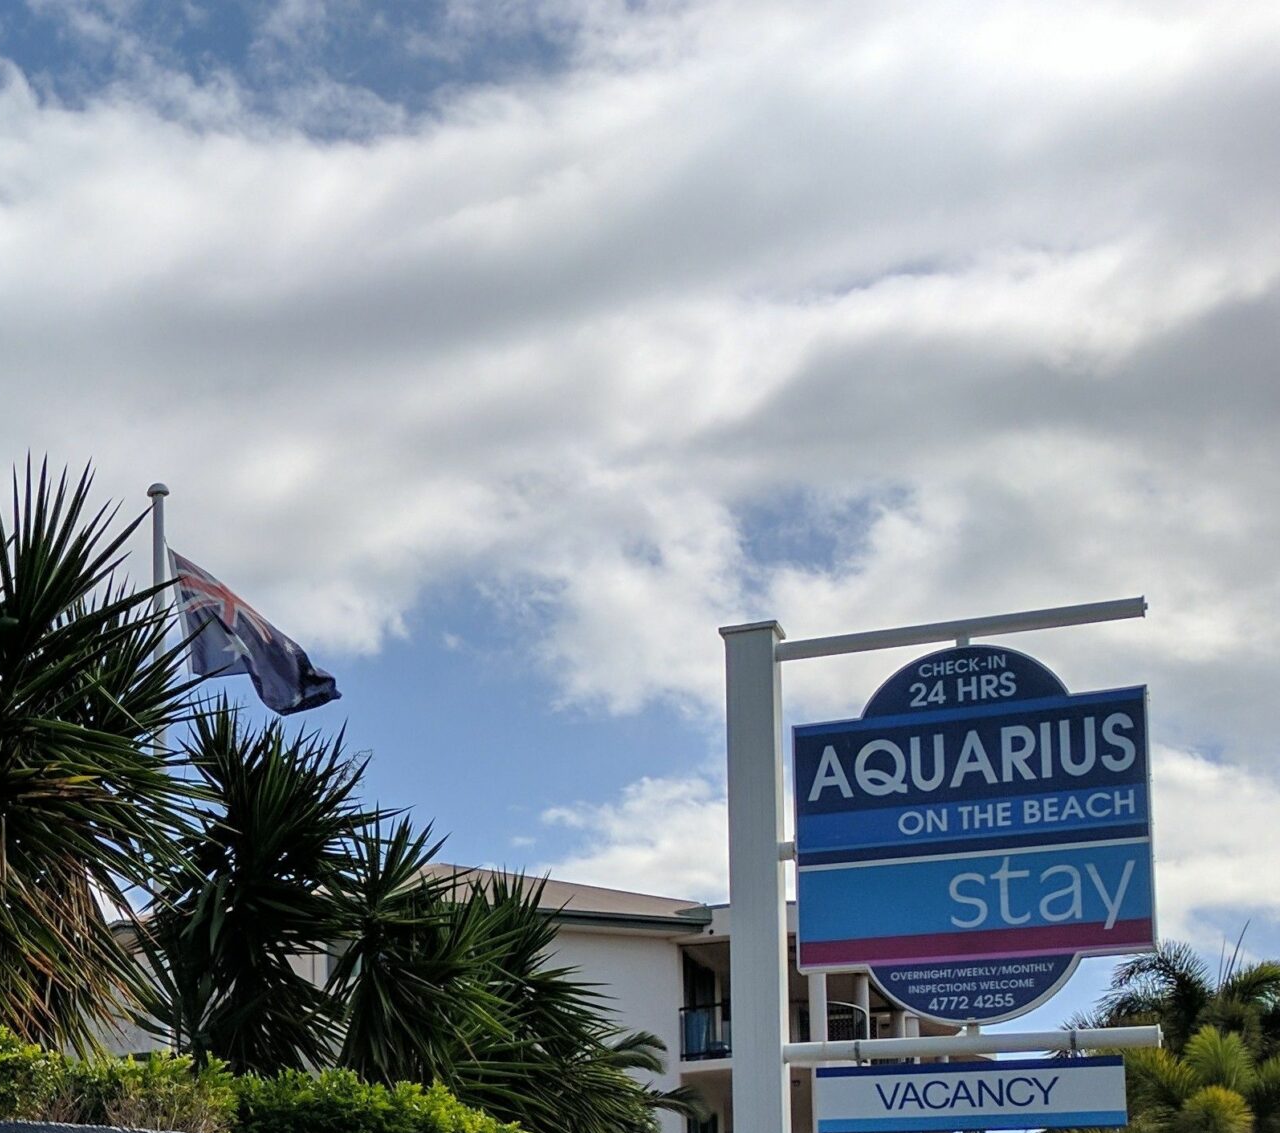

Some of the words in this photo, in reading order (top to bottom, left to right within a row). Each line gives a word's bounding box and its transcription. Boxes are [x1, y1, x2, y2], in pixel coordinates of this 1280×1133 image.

[919, 654, 1006, 678] CHECK-IN
[909, 681, 946, 707] 24
[957, 671, 1017, 702] HRS
[808, 712, 1136, 802] AQUARIUS
[898, 808, 948, 835] ON
[958, 802, 1011, 829] THE
[1023, 789, 1135, 824] BEACH
[948, 856, 1136, 930] stay
[908, 981, 977, 994] INSPECTIONS
[980, 978, 1035, 991] WELCOME
[928, 996, 969, 1011] 4772
[973, 993, 1015, 1009] 4255
[875, 1076, 1059, 1110] VACANCY
